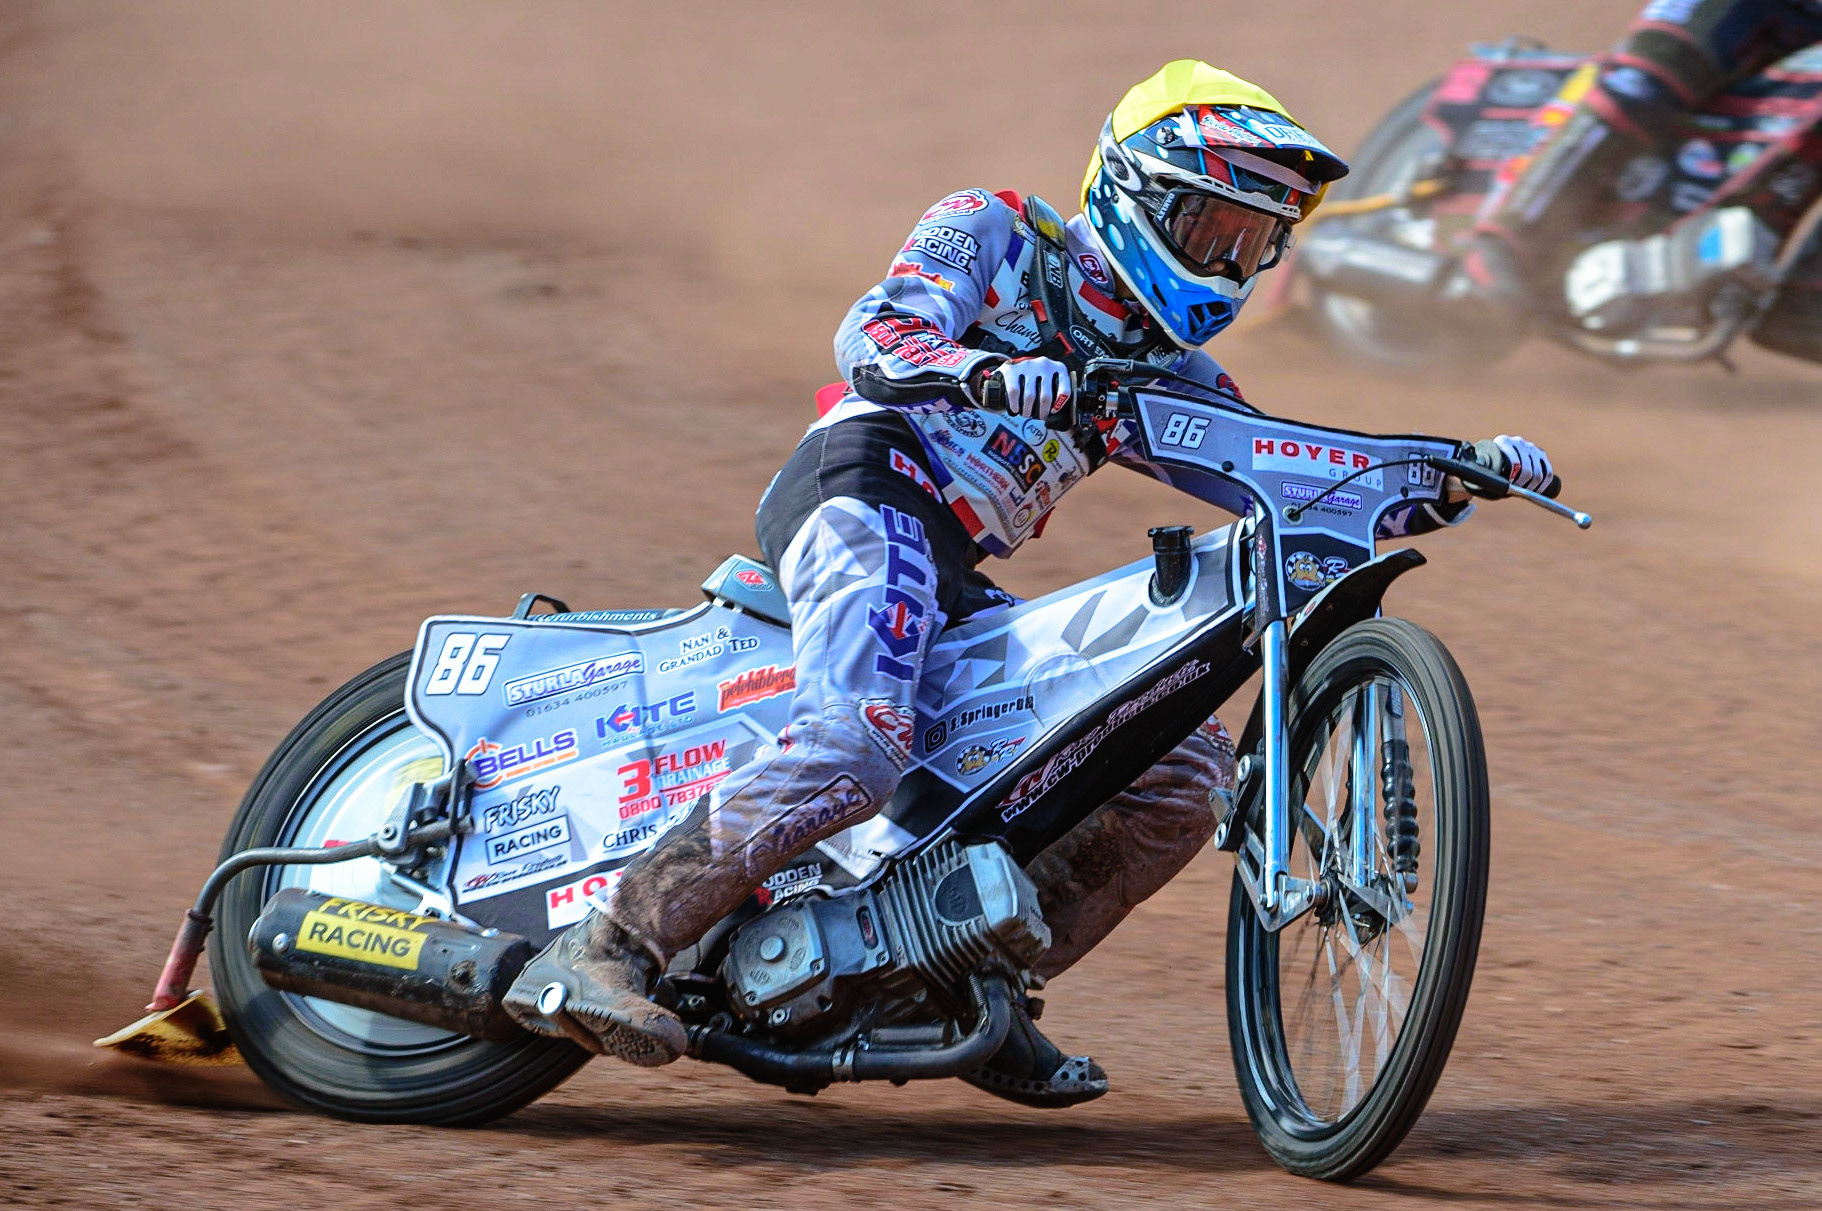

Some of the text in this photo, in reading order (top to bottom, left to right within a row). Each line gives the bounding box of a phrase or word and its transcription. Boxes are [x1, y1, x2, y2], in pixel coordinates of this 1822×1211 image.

[1156, 194, 1175, 222] OAKLEY
[1160, 413, 1212, 449] 86
[991, 431, 1043, 485] NSSC
[1254, 439, 1370, 469] HOYER
[1320, 508, 1353, 517] 400597
[1327, 491, 1361, 507] Garage
[867, 504, 926, 682] KITE
[717, 627, 730, 640] &
[425, 632, 512, 696] 86
[525, 681, 629, 718] 01634 400597
[596, 692, 697, 738] KITE
[475, 730, 577, 777] BELLS
[617, 758, 652, 804] 3
[653, 738, 727, 775] FLOW
[483, 785, 562, 834] FRISKY
[618, 795, 663, 820] 0800
[494, 824, 563, 858] RACING
[603, 824, 657, 849] CHRIS
[550, 871, 625, 909] HO
[762, 862, 823, 886] UDDEN
[317, 897, 438, 931] FRISKY
[308, 921, 411, 958] RACING
